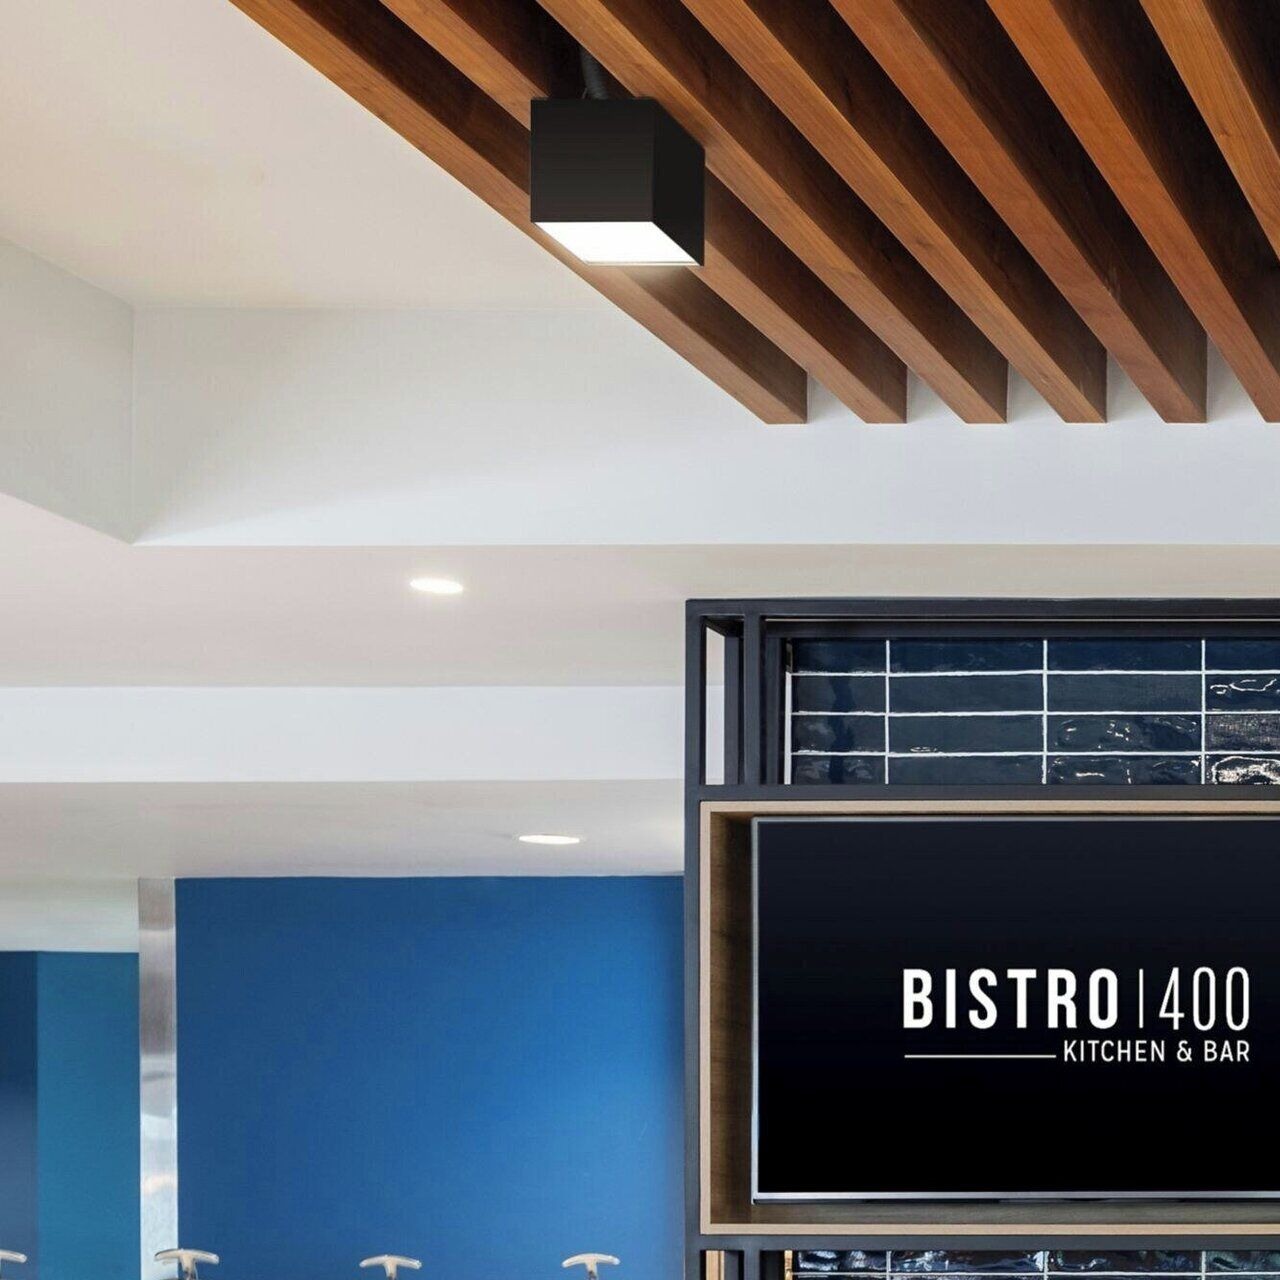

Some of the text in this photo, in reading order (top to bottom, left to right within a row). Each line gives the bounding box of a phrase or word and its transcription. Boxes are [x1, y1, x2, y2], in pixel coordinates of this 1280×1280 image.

[903, 966, 1250, 1031] BISTRO 400
[1063, 1040, 1250, 1063] KITCHEN & BAR
